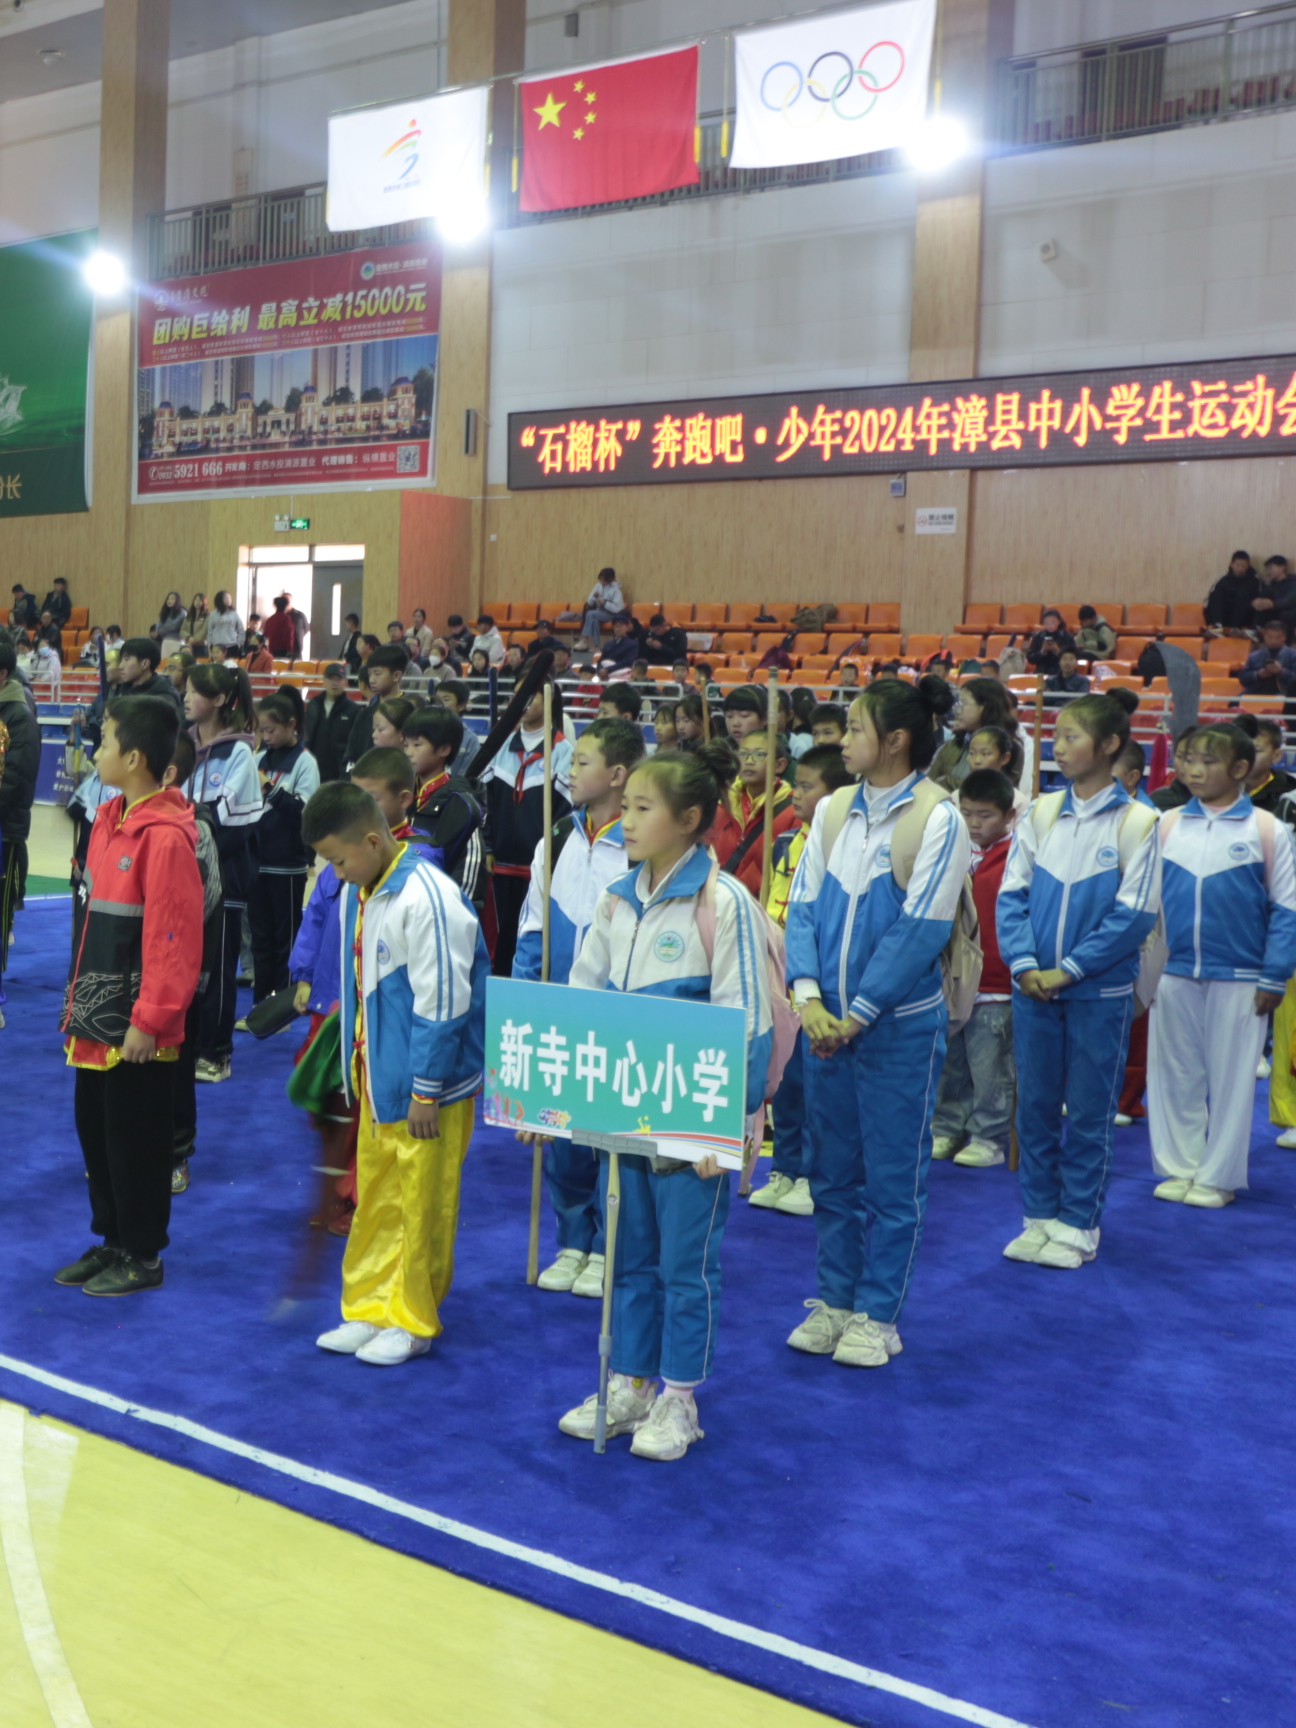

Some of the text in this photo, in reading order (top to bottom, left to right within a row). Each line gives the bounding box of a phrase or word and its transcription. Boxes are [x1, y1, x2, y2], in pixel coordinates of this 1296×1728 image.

[153, 305, 251, 345] 团购巨给利
[257, 282, 427, 330] 最高立减15000元
[174, 463, 200, 479] 5921
[202, 461, 223, 476] 666
[499, 1019, 729, 1122] 新寺中心小学
